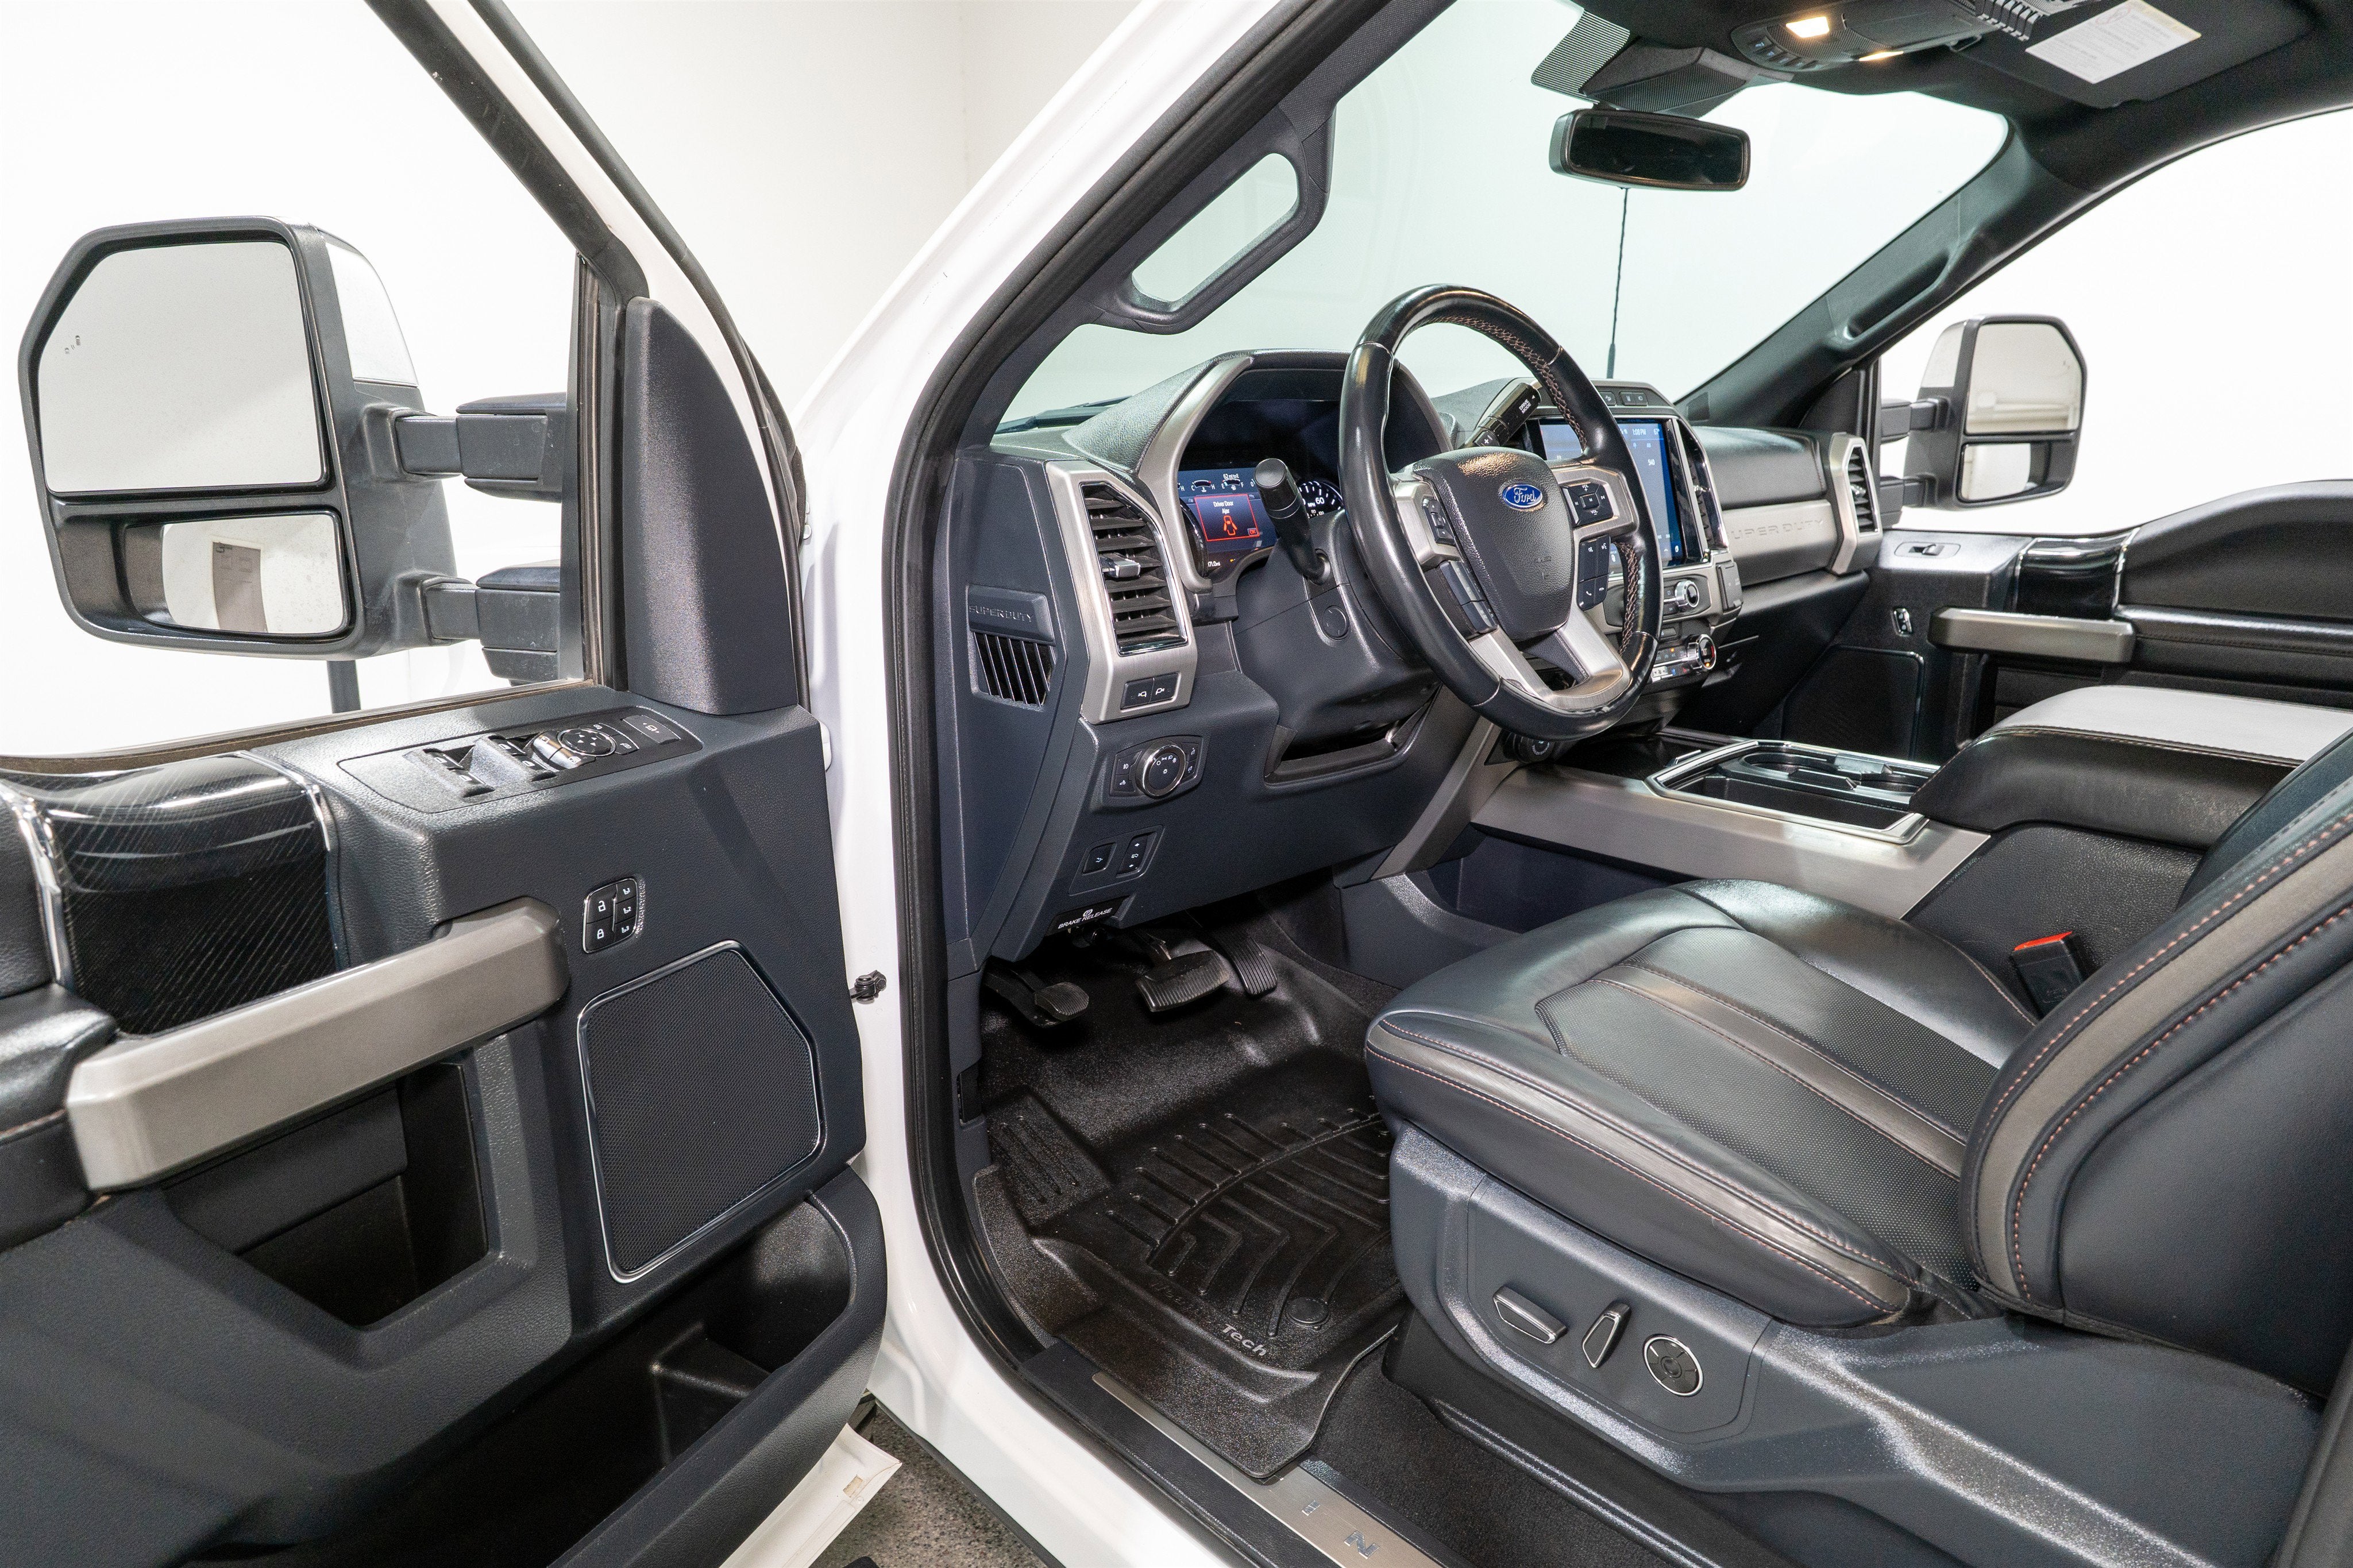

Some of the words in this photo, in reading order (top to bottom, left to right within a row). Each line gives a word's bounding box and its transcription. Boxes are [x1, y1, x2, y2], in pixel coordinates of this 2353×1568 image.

[1519, 399, 1529, 411] DRIVE
[1522, 402, 1532, 414] MODE
[1513, 487, 1537, 503] Ford
[1731, 525, 1779, 540] UPER
[1005, 609, 1034, 622] DUTY
[1058, 917, 1082, 929] BRAKE
[1081, 907, 1113, 921] RELEASE
